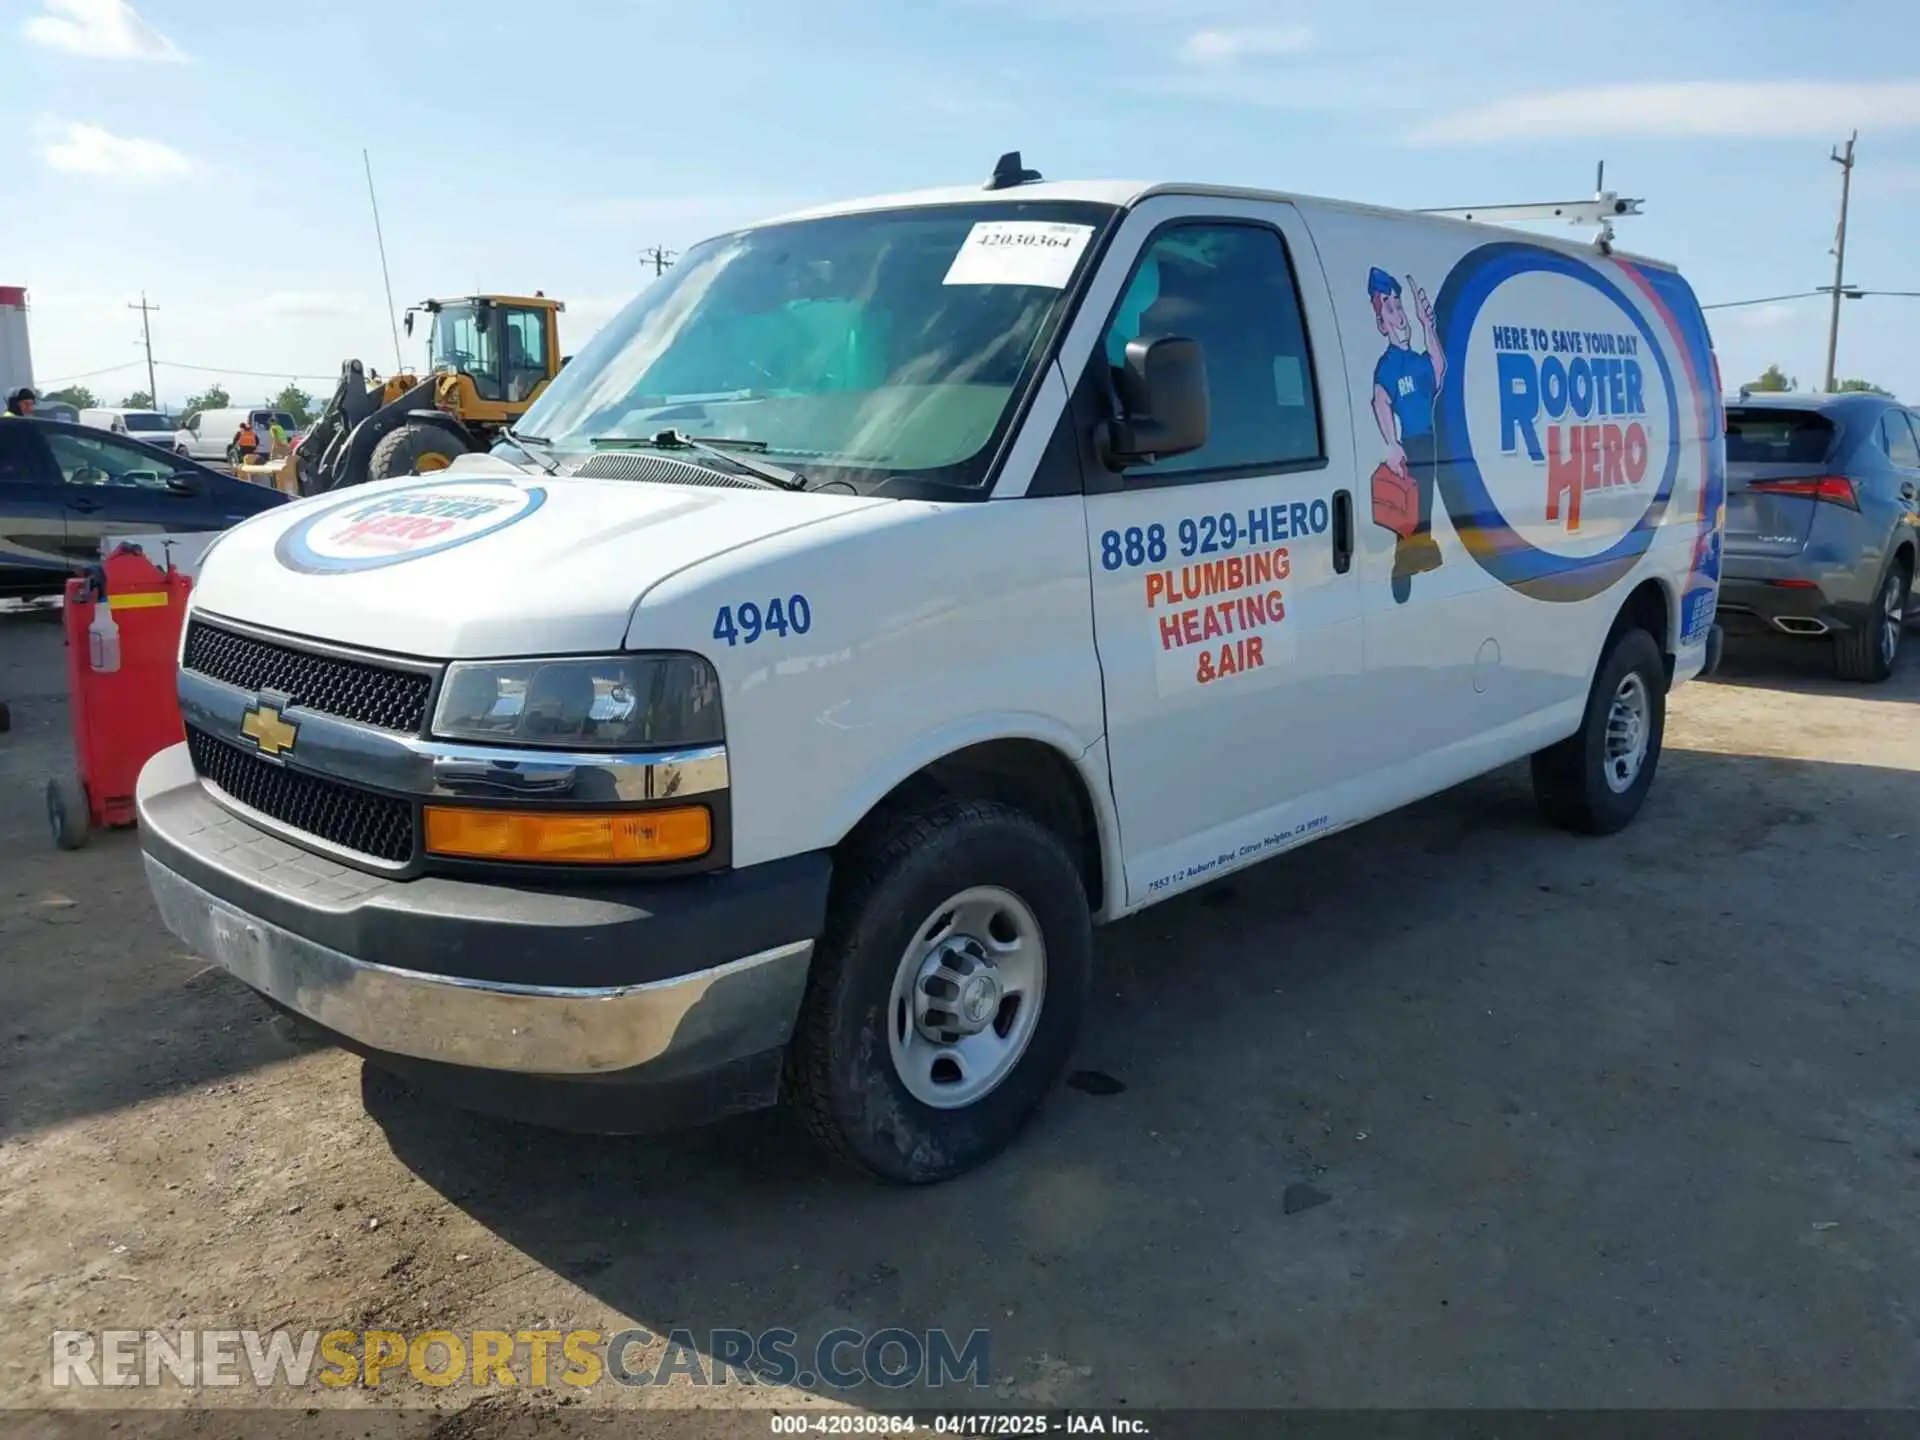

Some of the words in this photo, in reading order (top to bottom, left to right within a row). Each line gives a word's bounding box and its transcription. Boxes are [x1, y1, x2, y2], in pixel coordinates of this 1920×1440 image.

[976, 233, 1072, 248] 42030364
[1493, 325, 1529, 350] HERE
[1530, 328, 1549, 351] TO
[1552, 330, 1583, 353] SAVE
[1583, 332, 1616, 355] YOUR
[1617, 335, 1637, 356] DAY
[1496, 352, 1645, 463] ROOTER
[1546, 422, 1648, 533] HERO
[1101, 523, 1167, 571] 888
[1178, 498, 1329, 557] 929-HERO
[1145, 548, 1290, 608] PLUMBING
[713, 593, 811, 647] 4940
[1158, 590, 1286, 651] HEATING
[1196, 636, 1264, 684] &AIR
